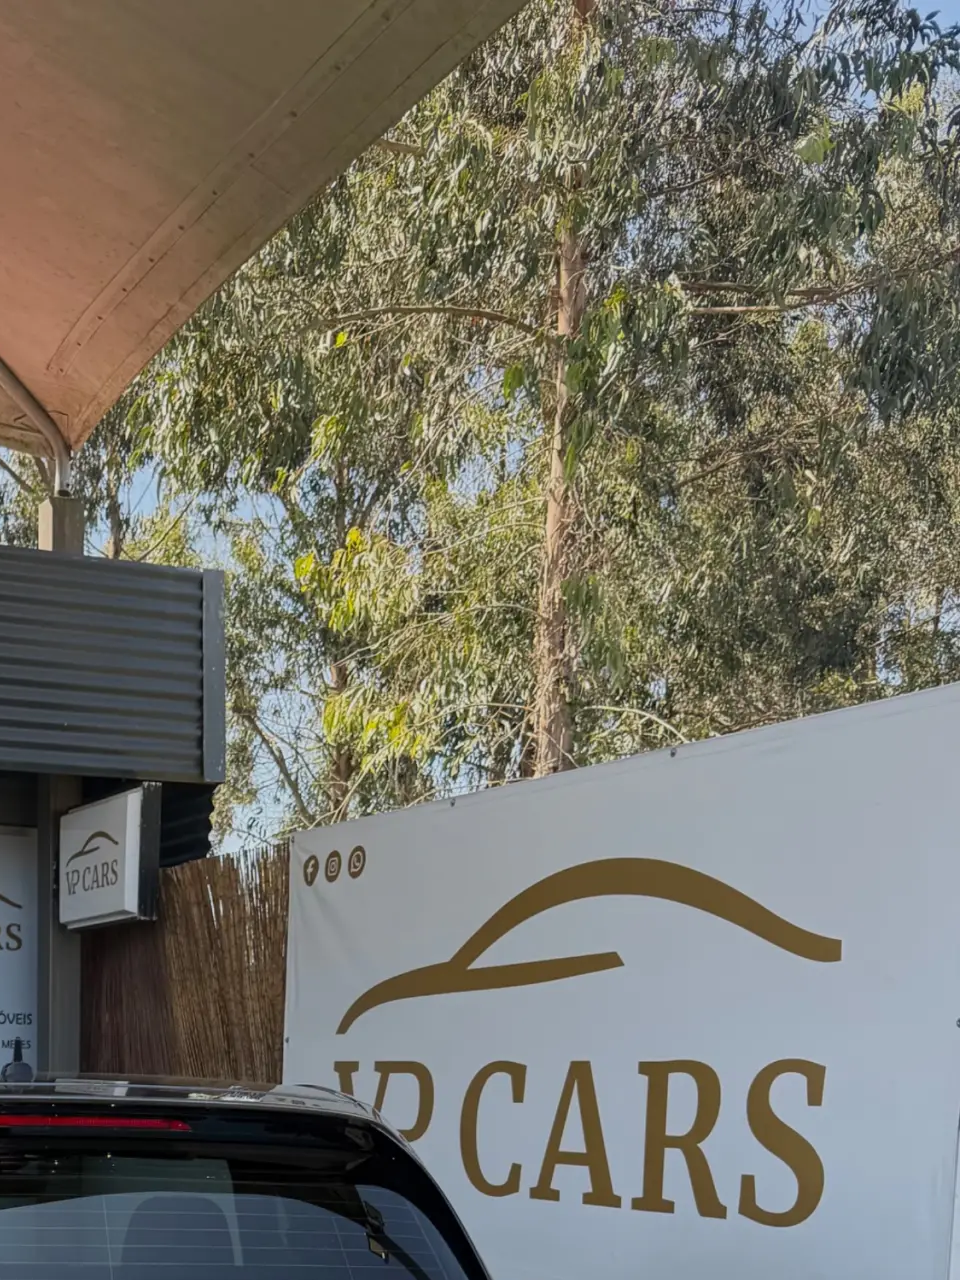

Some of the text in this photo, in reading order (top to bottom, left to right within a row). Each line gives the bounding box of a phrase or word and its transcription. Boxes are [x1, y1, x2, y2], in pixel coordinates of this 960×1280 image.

[65, 859, 119, 896] VP CARS
[1, 1039, 32, 1049] MEES
[459, 1058, 826, 1227] CARS
